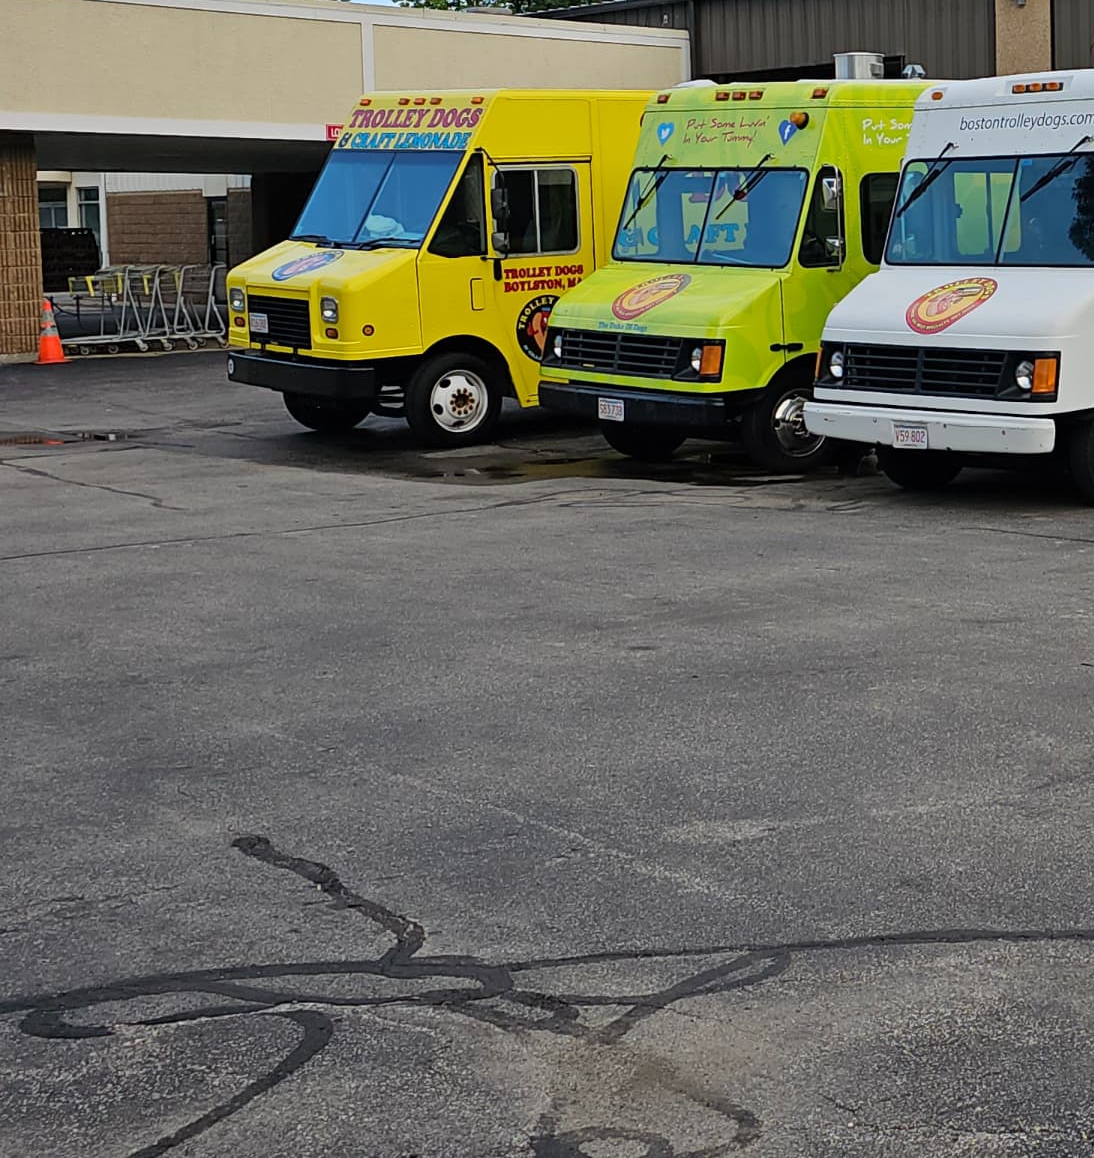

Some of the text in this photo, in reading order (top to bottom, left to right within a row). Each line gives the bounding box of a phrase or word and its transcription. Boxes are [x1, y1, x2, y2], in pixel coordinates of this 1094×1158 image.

[349, 108, 483, 128] TROLLEY DOGS
[862, 118, 913, 131] Put Som
[351, 132, 396, 148] CRAFT
[395, 132, 472, 149] LEMONADE
[876, 132, 903, 146] Your
[504, 264, 584, 279] TROLLEY DOGS
[504, 278, 566, 293] BOYLSTON,
[518, 296, 555, 330] TROLLEY
